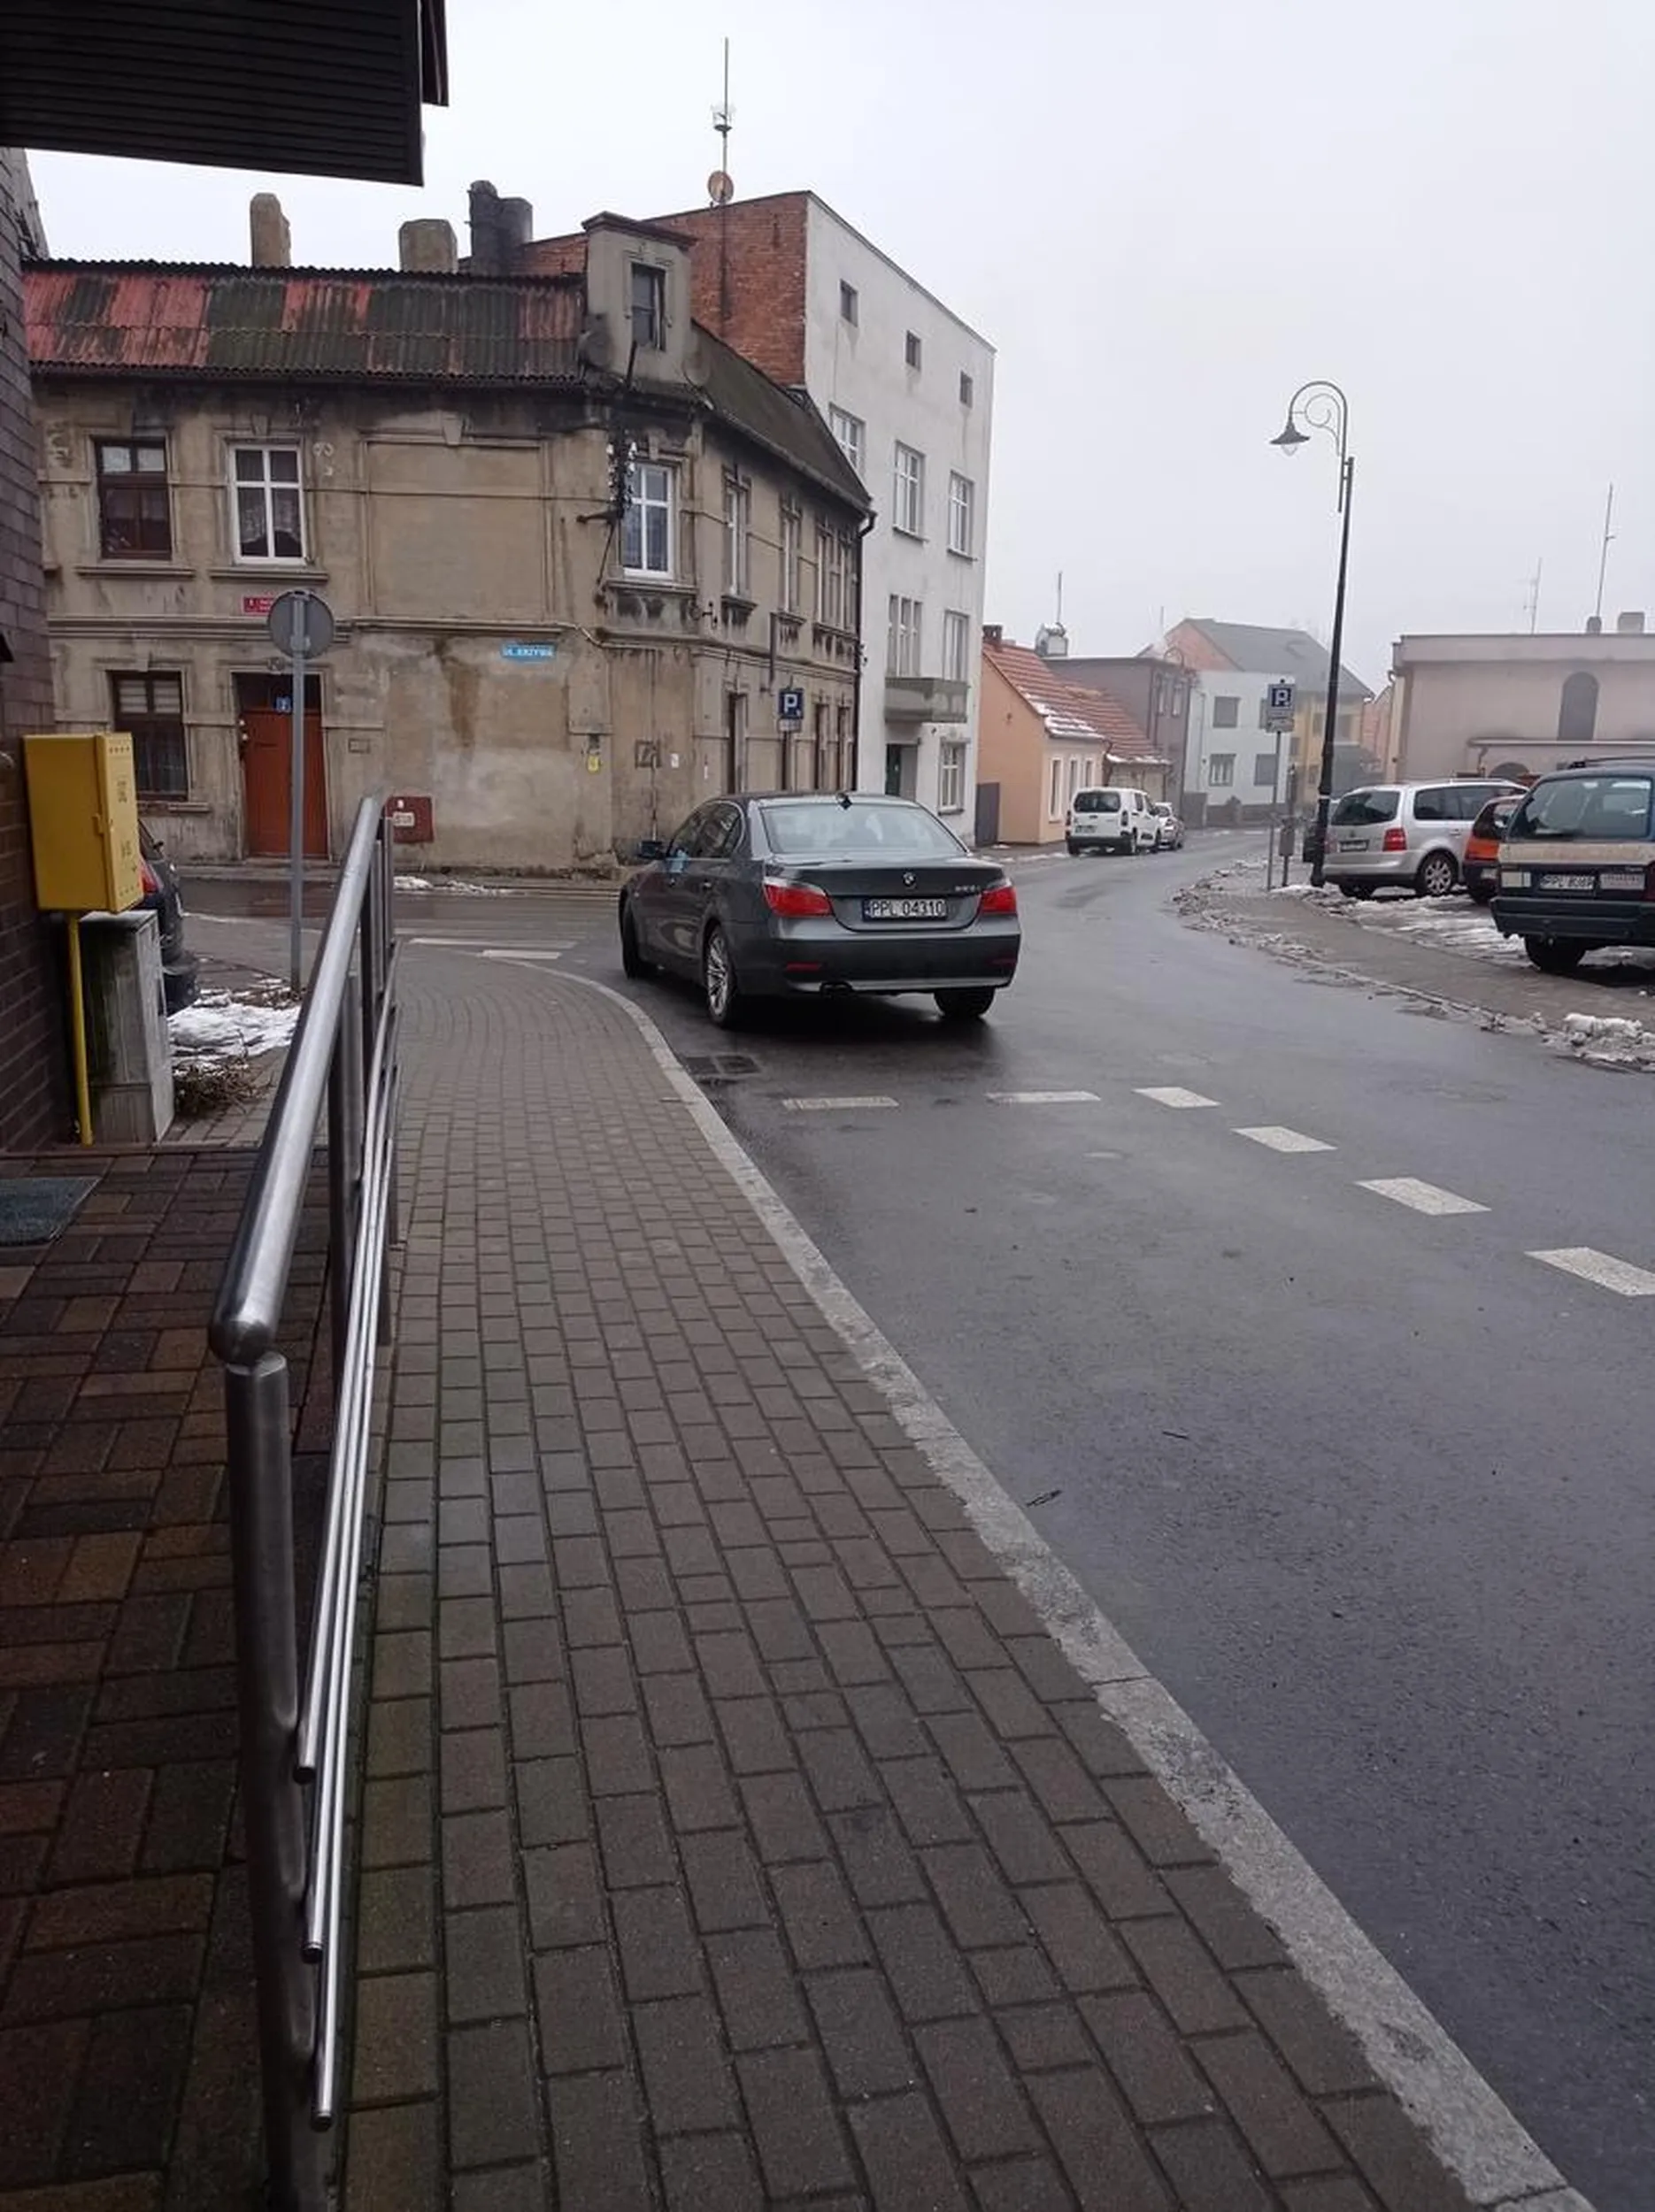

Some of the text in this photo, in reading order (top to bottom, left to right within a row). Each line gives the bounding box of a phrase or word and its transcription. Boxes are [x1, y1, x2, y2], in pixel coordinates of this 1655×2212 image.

[784, 694, 797, 713] P
[1275, 689, 1289, 705] P
[871, 899, 946, 917] PPL 04310
